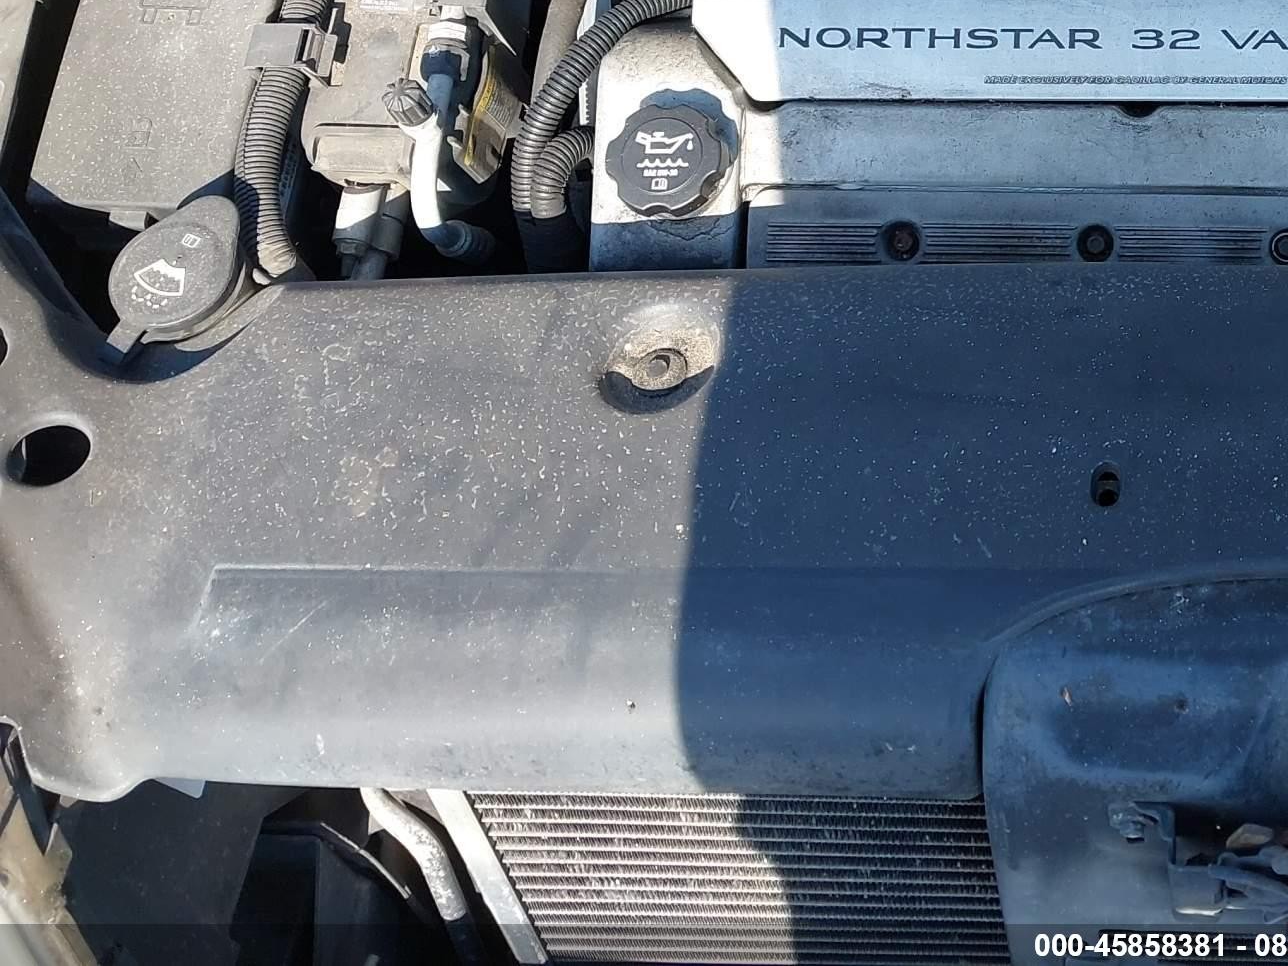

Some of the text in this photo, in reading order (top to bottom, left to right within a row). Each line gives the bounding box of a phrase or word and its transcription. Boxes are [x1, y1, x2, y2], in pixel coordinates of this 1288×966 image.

[778, 27, 1103, 50] NORTHSTAR
[1131, 28, 1201, 50] 32
[984, 73, 1288, 85] MADE EXCLUSIVELY FOR CADILLAC BY GENERAL MOTORS
